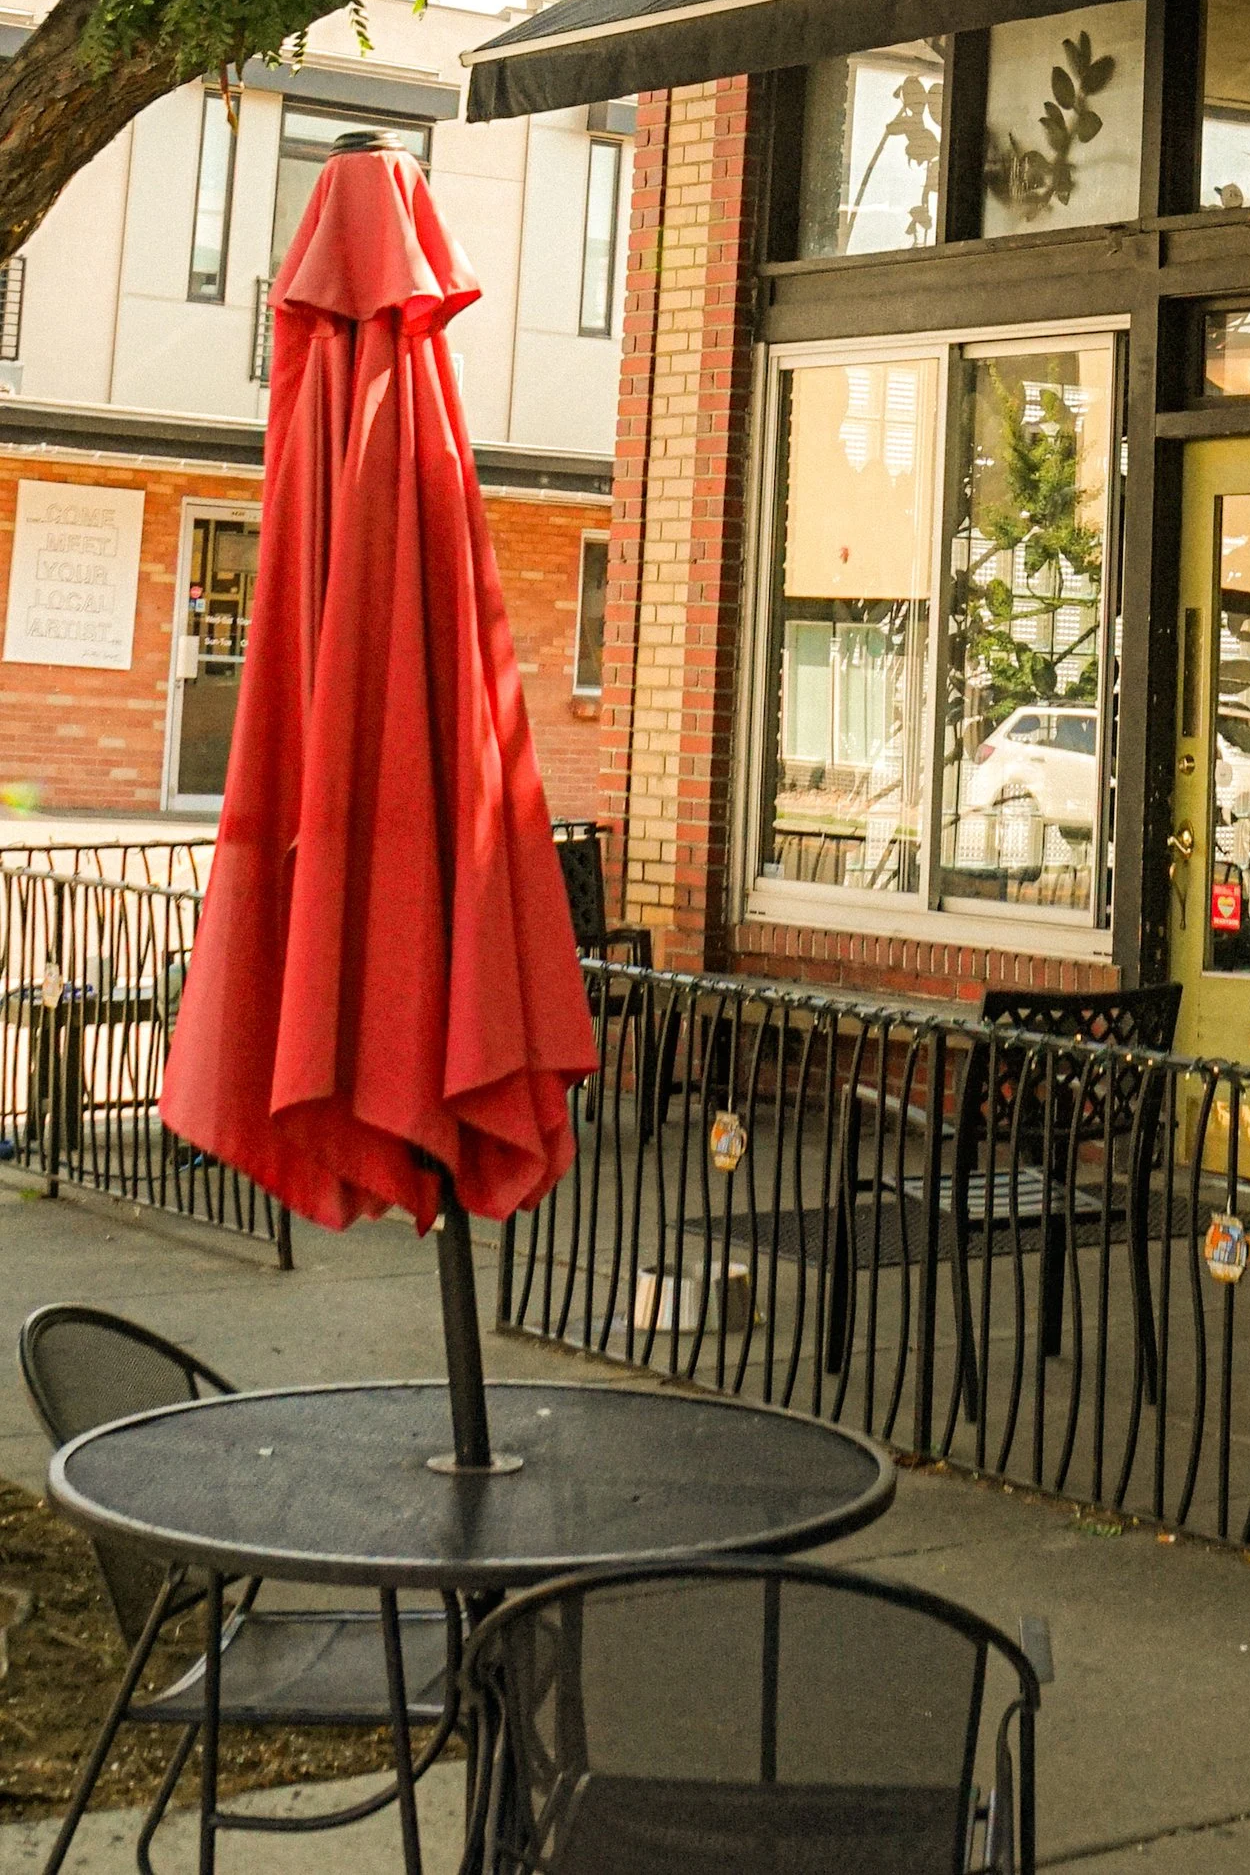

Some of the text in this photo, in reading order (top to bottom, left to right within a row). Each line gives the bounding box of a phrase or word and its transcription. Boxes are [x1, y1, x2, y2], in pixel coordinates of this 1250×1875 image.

[45, 503, 117, 526] COME
[45, 532, 112, 556] MEET
[42, 559, 109, 585] YOUR
[35, 588, 111, 614] LOCAL
[28, 617, 114, 642] ARTIST
